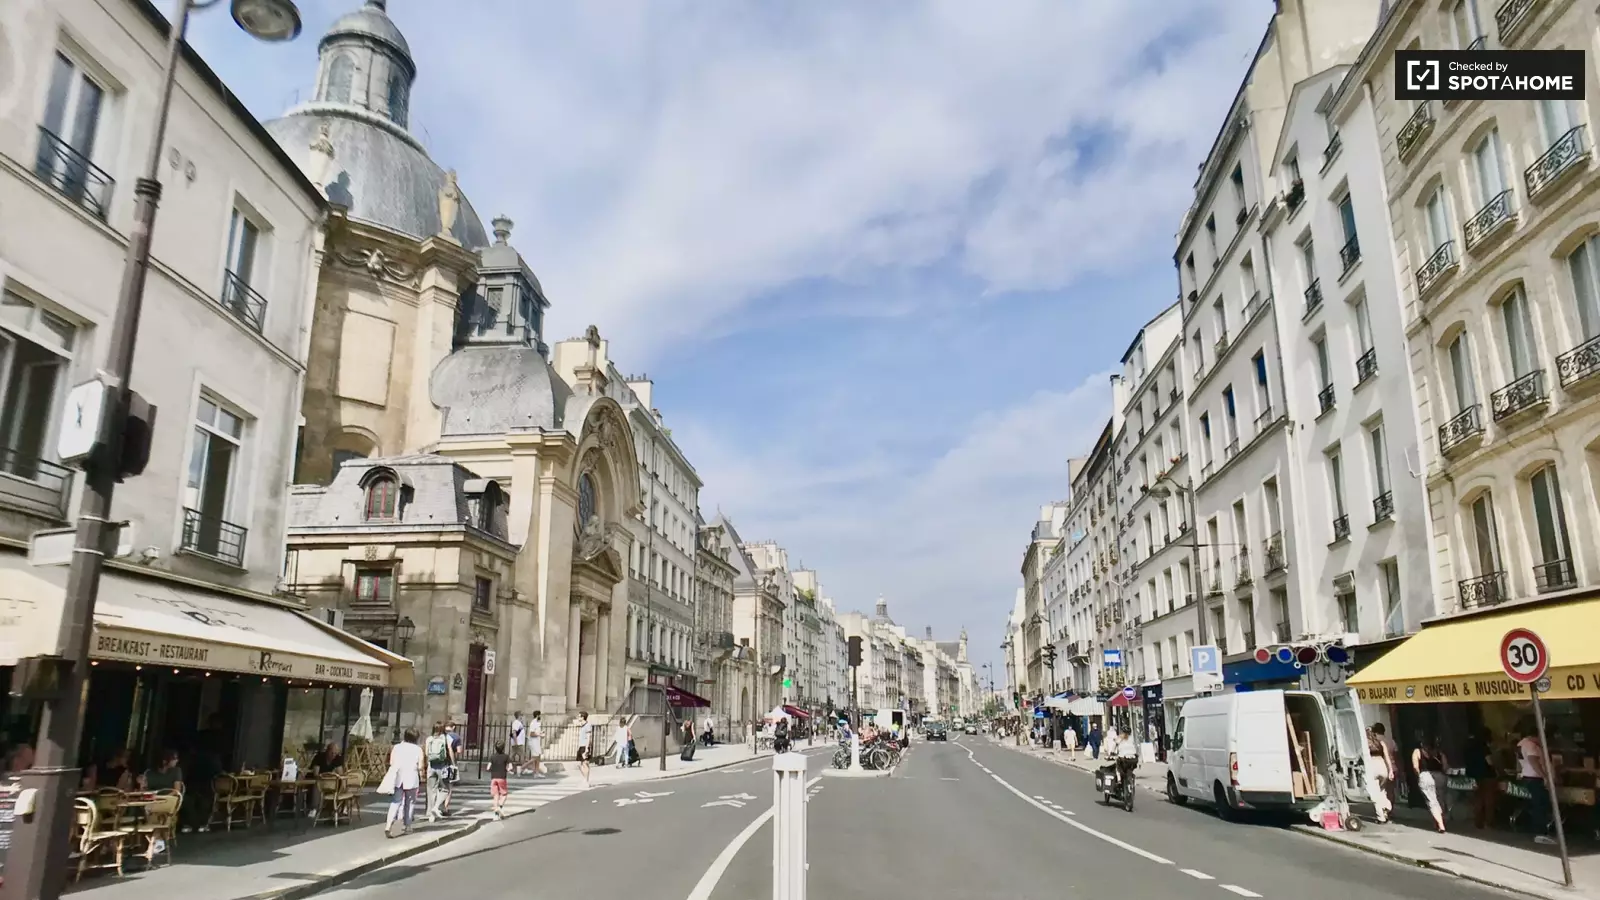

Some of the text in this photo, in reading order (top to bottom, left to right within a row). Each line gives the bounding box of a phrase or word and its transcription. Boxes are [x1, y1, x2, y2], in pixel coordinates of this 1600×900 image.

[97, 636, 151, 657] BREAKFAST
[160, 644, 209, 662] RESTAURANT
[1508, 643, 1538, 668] 30
[1197, 651, 1210, 669] P
[315, 664, 326, 675] BAR
[329, 666, 353, 678] COCKTAILS
[1424, 683, 1458, 698] CINEMA
[1463, 682, 1471, 696] &
[1475, 680, 1525, 696] MUSIQUE
[1566, 674, 1586, 691] CD
[1369, 687, 1397, 700] BLU-RAY
